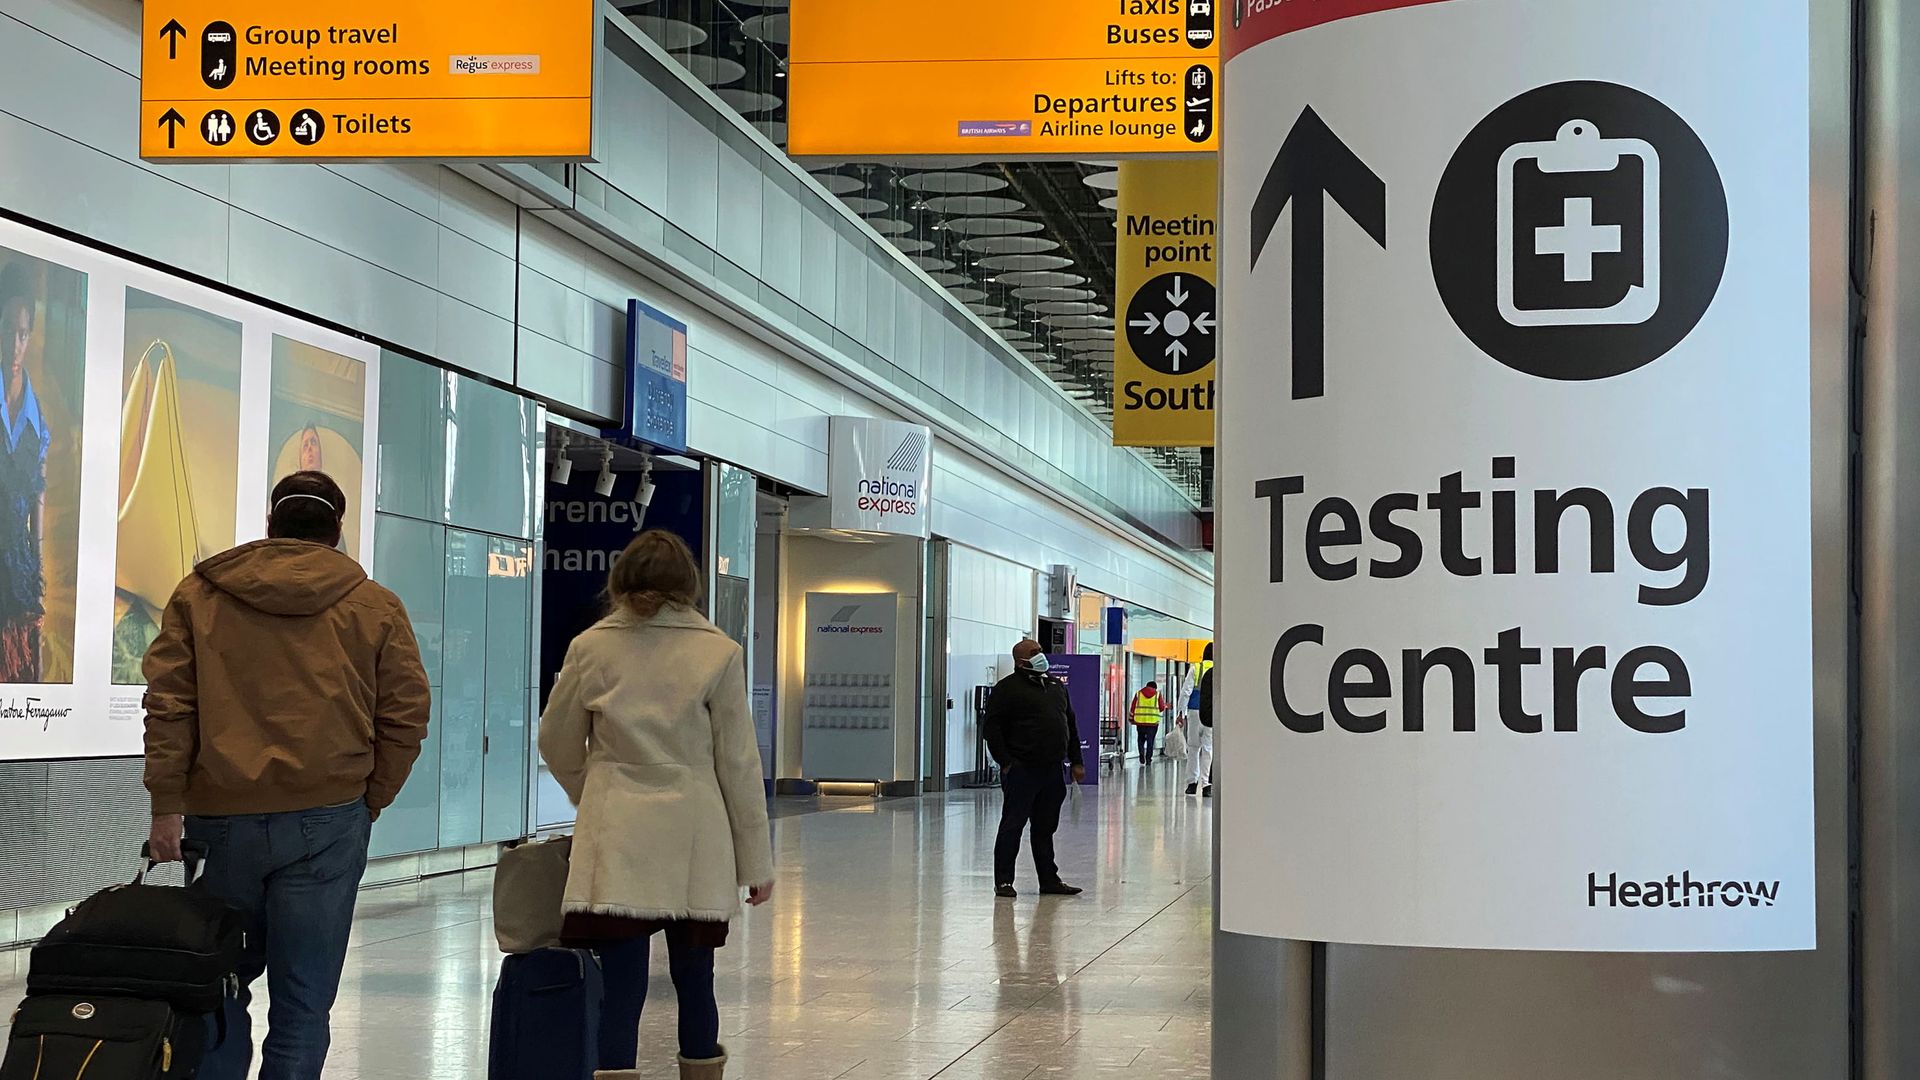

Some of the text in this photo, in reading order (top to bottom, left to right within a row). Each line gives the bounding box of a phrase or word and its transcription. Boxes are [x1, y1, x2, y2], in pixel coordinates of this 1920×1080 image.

[1118, 0, 1180, 16] Taxis
[245, 23, 397, 51] Group travel
[1107, 24, 1180, 45] Buses
[245, 54, 430, 81] Meeting rooms
[456, 56, 533, 74] Regus express
[1105, 69, 1177, 86] Lifts to:
[1033, 93, 1177, 119] Departures
[332, 112, 411, 134] Toilets
[961, 127, 983, 135] BRITISH
[1039, 119, 1177, 140] Airline lounge
[1126, 213, 1216, 236] Meetin
[1145, 240, 1212, 268] point
[858, 475, 917, 499] national
[545, 500, 647, 532] rency
[857, 496, 917, 517] express
[1254, 456, 1710, 606] Testing
[817, 624, 883, 635] national express
[1269, 623, 1692, 734] Centre
[25, 697, 73, 732] Ferragamo
[1587, 869, 1780, 908] Heathrow
